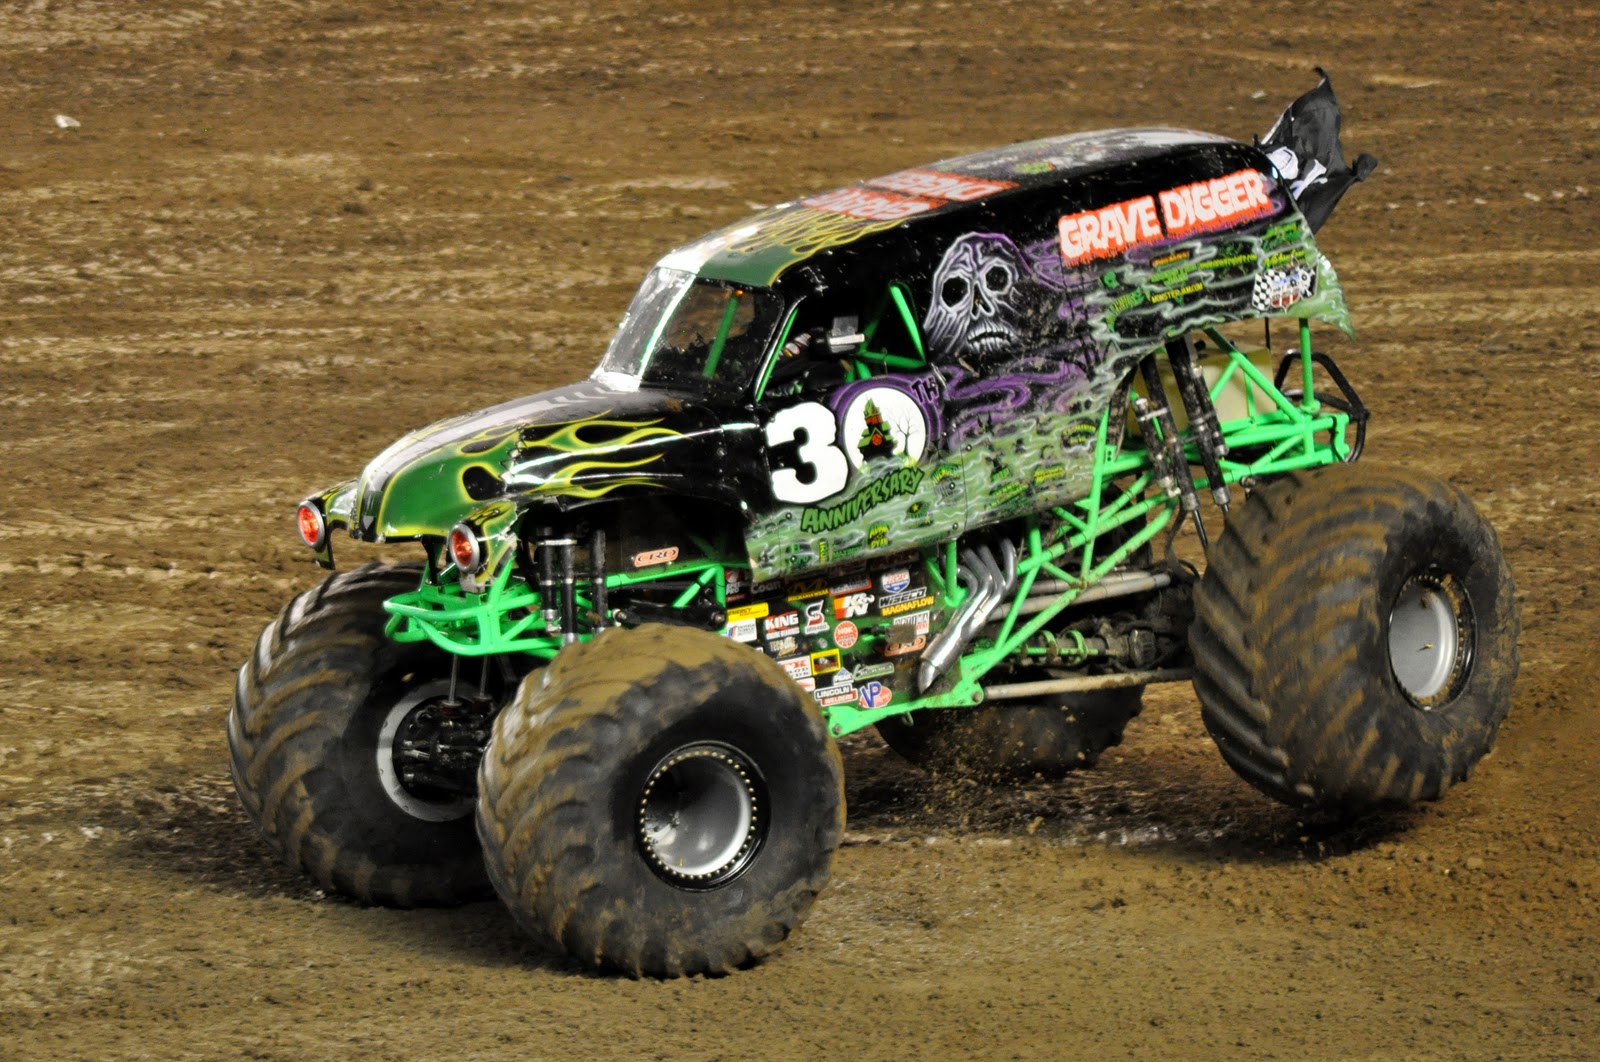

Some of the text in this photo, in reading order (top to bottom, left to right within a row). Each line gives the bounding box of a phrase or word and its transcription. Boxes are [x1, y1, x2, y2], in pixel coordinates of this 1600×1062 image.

[1059, 170, 1269, 259] GRAVE DIGGER
[911, 376, 940, 403] TH
[799, 466, 925, 534] ANNIVERSARY
[881, 595, 935, 616] MAGNAFLOW
[766, 612, 799, 631] KING
[815, 685, 851, 700] LINCOLN
[860, 682, 881, 708] VP
